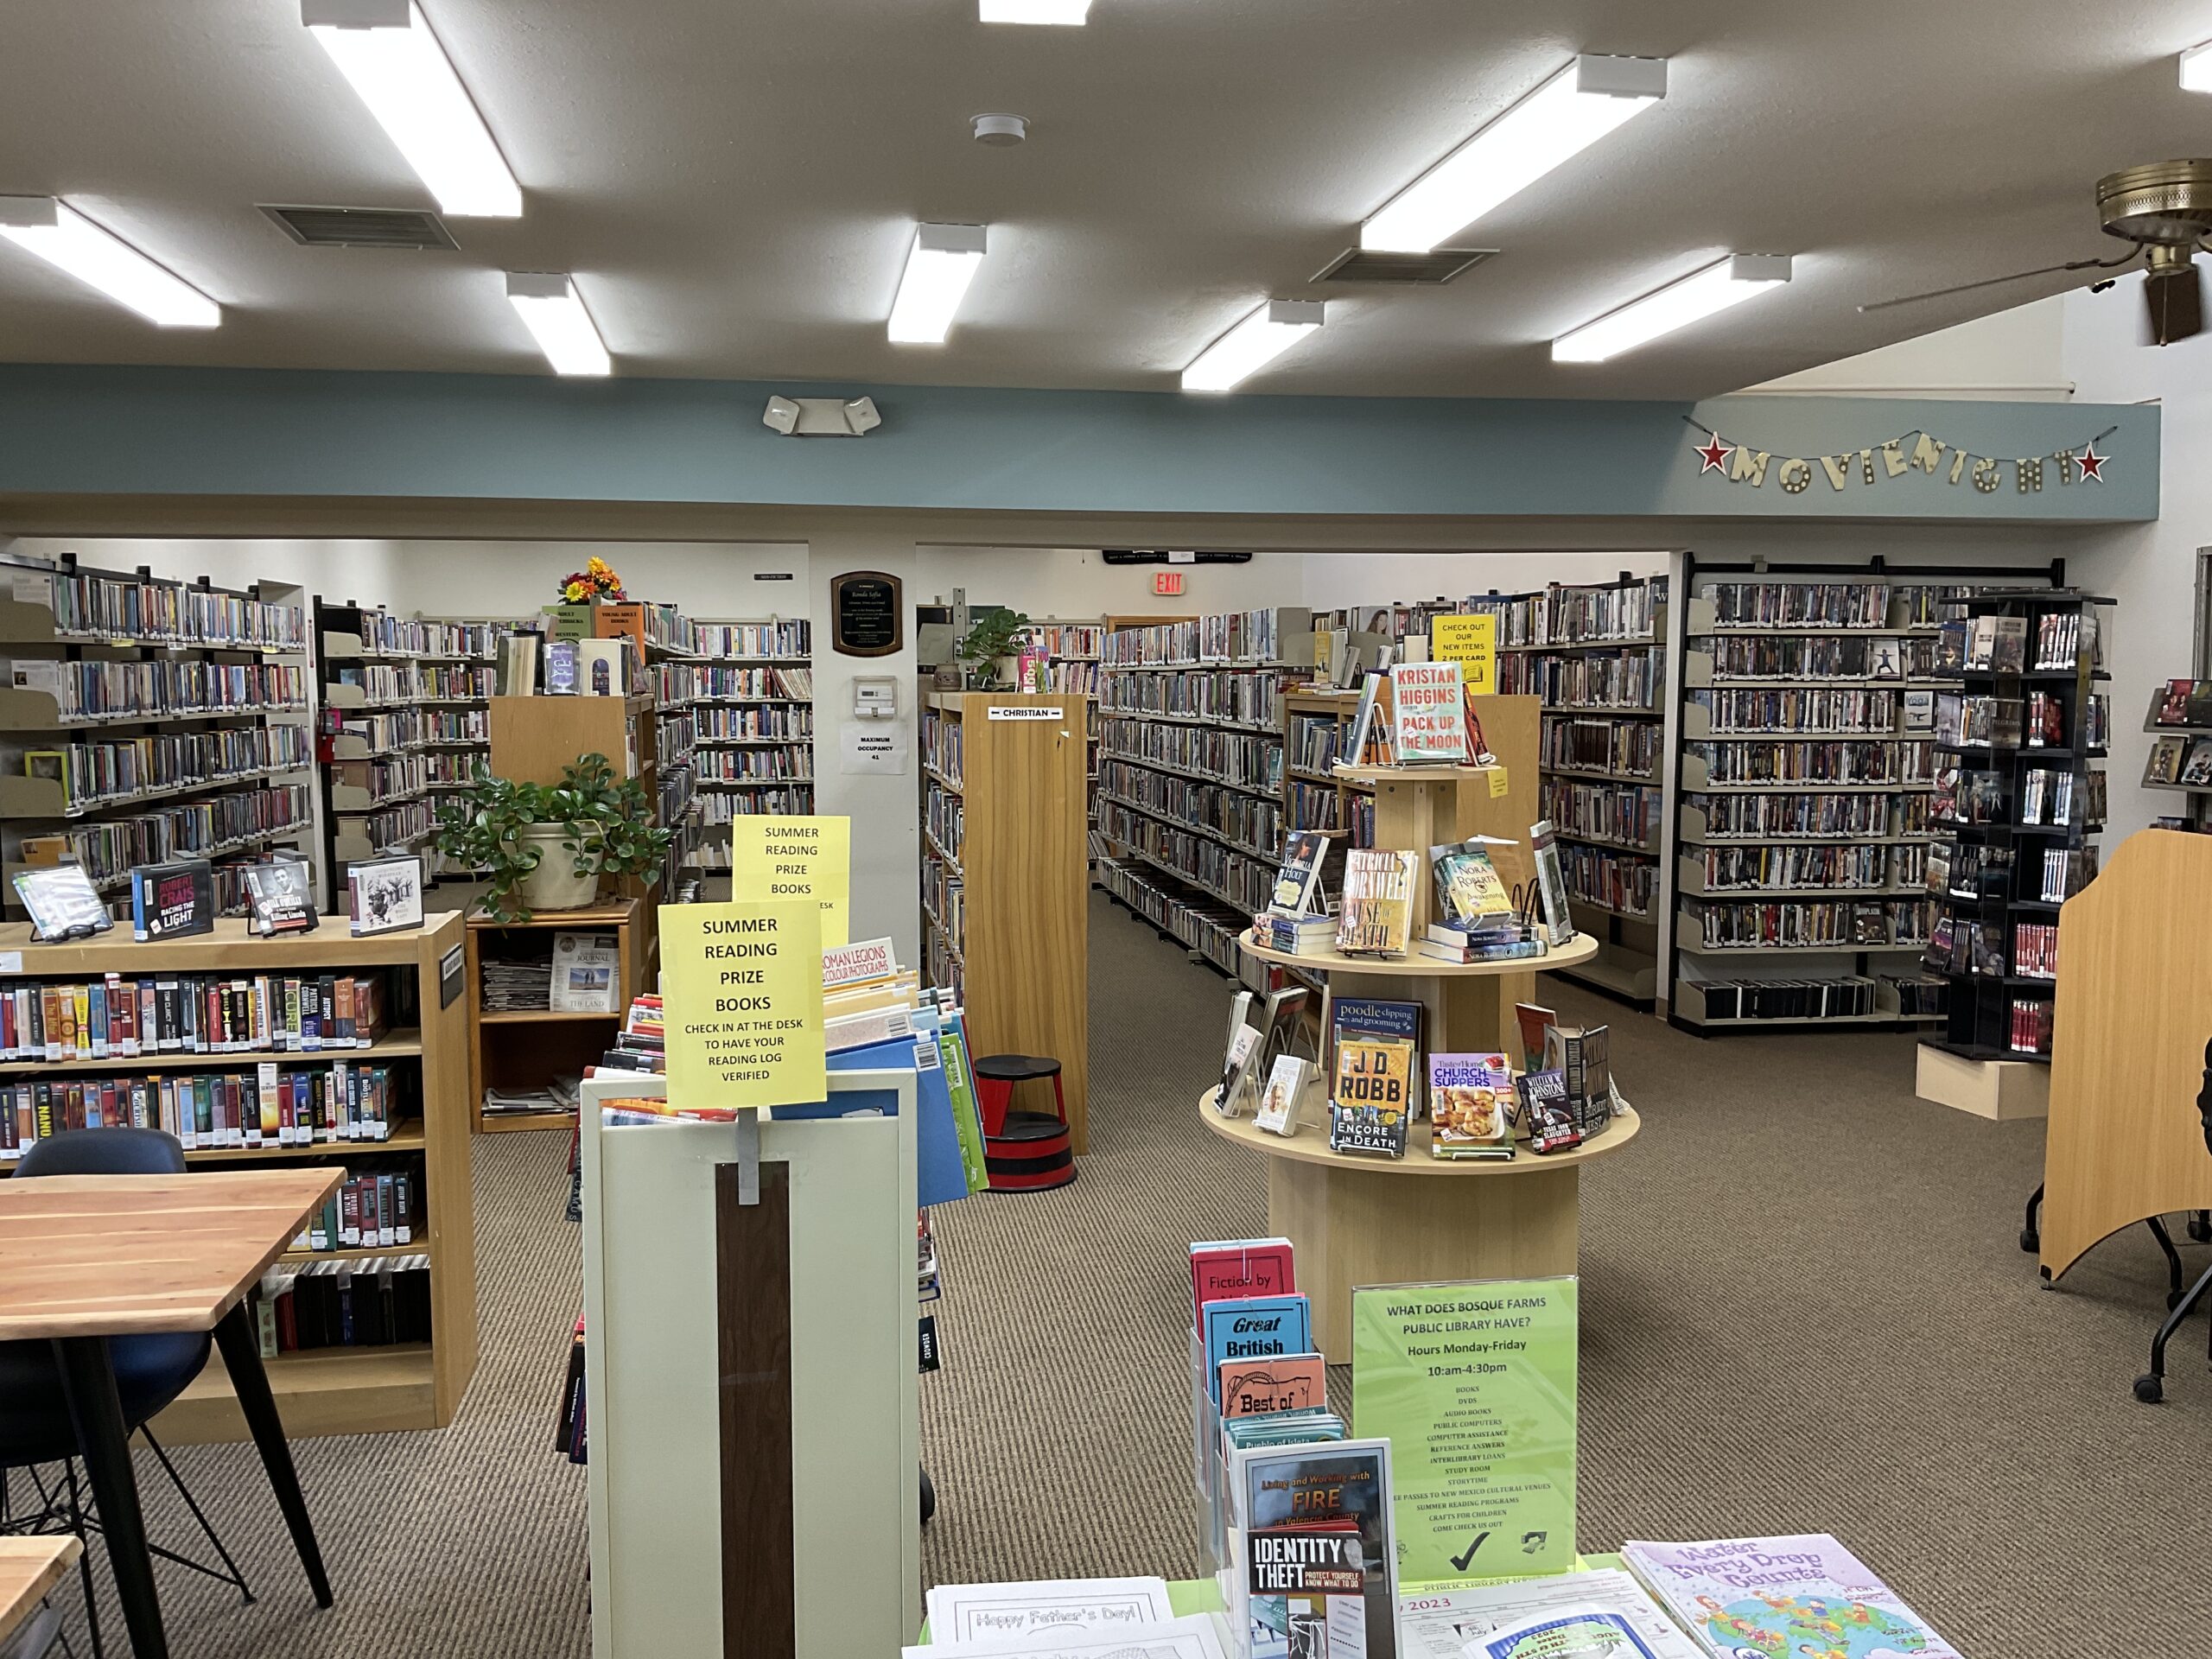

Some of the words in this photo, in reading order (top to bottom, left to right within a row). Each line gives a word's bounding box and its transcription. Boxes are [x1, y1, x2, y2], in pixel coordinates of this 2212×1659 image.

[1730, 439, 1908, 493] MOVIE
[1910, 433, 2073, 493] NIGHT
[1157, 574, 1182, 593] EXIT
[1397, 669, 1456, 685] KRISTAN
[1400, 689, 1456, 705] HIGGINS
[1402, 716, 1434, 731] PACK
[1439, 716, 1455, 729] UP
[1401, 735, 1421, 749] THE
[1427, 735, 1461, 748] MOON
[765, 827, 819, 838] SUMMER
[766, 845, 818, 855] READING
[776, 865, 808, 874] PRIZE
[1285, 867, 1303, 880] HOLT
[1458, 866, 1488, 875] NORA
[159, 874, 194, 893] ROBERT
[1457, 875, 1497, 887] ROBERTS
[771, 884, 811, 894] BOOKS
[159, 887, 194, 908] CRAIS
[1467, 892, 1505, 903] Awakening
[161, 905, 183, 916] RACING
[163, 910, 194, 928] LIGHT
[702, 918, 778, 934] SUMMER
[705, 943, 778, 959] READING
[851, 945, 887, 964] LEGIONS
[721, 970, 765, 985] PRIZE
[825, 967, 849, 982] COLOUR
[849, 960, 889, 977] PHOTOGRAPHS
[309, 988, 318, 1014] PATRICIA
[715, 997, 771, 1012] BOOKS
[285, 991, 298, 1032] CURE
[1340, 1005, 1381, 1017] poodle
[1381, 1008, 1412, 1020] clipping
[685, 1024, 721, 1034] CHECK
[722, 1023, 734, 1033] IN
[737, 1022, 750, 1032] AT
[752, 1020, 773, 1030] THE
[777, 1019, 804, 1029] DESK
[1363, 1018, 1401, 1028] grooming
[705, 1040, 720, 1050] TO
[722, 1039, 752, 1048] HAVE
[754, 1037, 785, 1047] YOUR
[709, 1055, 758, 1065] READING
[760, 1053, 782, 1063] LOG
[1353, 1051, 1369, 1074] J.
[1374, 1051, 1390, 1075] D.
[721, 1071, 770, 1082] VERIFIED
[1434, 1068, 1486, 1077] CHURCH
[1525, 1073, 1553, 1087] WILLIAM
[1340, 1076, 1401, 1103] ROBB
[1435, 1077, 1491, 1087] SUPPERS
[1528, 1081, 1566, 1097] JOHNSTONE
[37, 1106, 52, 1137] NANO
[1338, 1122, 1389, 1136] ENCORE
[1543, 1128, 1572, 1139] SLAUGHTER
[1342, 1135, 1351, 1143] IN
[1354, 1135, 1395, 1148] DEATH
[569, 1179, 582, 1221] CAMUS
[1210, 1276, 1251, 1289] Fiction
[1256, 1274, 1271, 1288] by
[1387, 1305, 1422, 1316] WHAT
[1425, 1303, 1455, 1313] DOES
[1458, 1300, 1504, 1313] BOSQUE
[1507, 1297, 1547, 1308] FARMS
[1233, 1316, 1281, 1333] Great
[1403, 1322, 1443, 1334] PUBLIC
[1446, 1319, 1491, 1332] LIBRARY
[1494, 1316, 1531, 1328] HAVE?
[922, 1332, 932, 1359] CROWDER
[1227, 1338, 1283, 1357] British
[1408, 1344, 1440, 1356] Hours
[1443, 1339, 1527, 1355] Monday-Friday
[1427, 1363, 1507, 1376] 10:am-4:30pm
[1240, 1394, 1279, 1412] Best
[1281, 1392, 1295, 1410] of
[1459, 1419, 1503, 1427] COMPUTERS
[1427, 1433, 1466, 1441] COMPUTER
[1466, 1429, 1509, 1438] ASSISTANCE
[1430, 1444, 1469, 1452] REFERENCE
[1471, 1441, 1505, 1450] ANSWERS
[1430, 1454, 1481, 1464] INTERLIBRARY
[1261, 1478, 1288, 1490] Living
[1291, 1476, 1307, 1486] and
[1310, 1474, 1347, 1485] Working
[1350, 1471, 1370, 1480] with
[1486, 1485, 1523, 1494] CULTURAL
[1293, 1488, 1340, 1511] FIRE
[1416, 1503, 1447, 1511] SUMMER
[1480, 1497, 1520, 1506] PROGRAMS
[1285, 1515, 1323, 1526] Valencia
[1471, 1510, 1508, 1518] CHILDREN
[1255, 1538, 1341, 1563] IDENTITY
[1676, 1541, 1758, 1561] Water
[1663, 1559, 1752, 1580] Every
[1747, 1553, 1822, 1568] Drop
[1255, 1563, 1306, 1588] THEFT
[1305, 1571, 1331, 1580] PROTECT
[1724, 1567, 1827, 1588] Counts
[1409, 1598, 1452, 1611] 2023
[976, 1613, 1024, 1630] Happy
[1030, 1609, 1096, 1624] Father's
[1102, 1605, 1135, 1621] Day!
[1530, 1630, 1555, 1640] 2023
[1536, 1633, 1567, 1644] Dates
